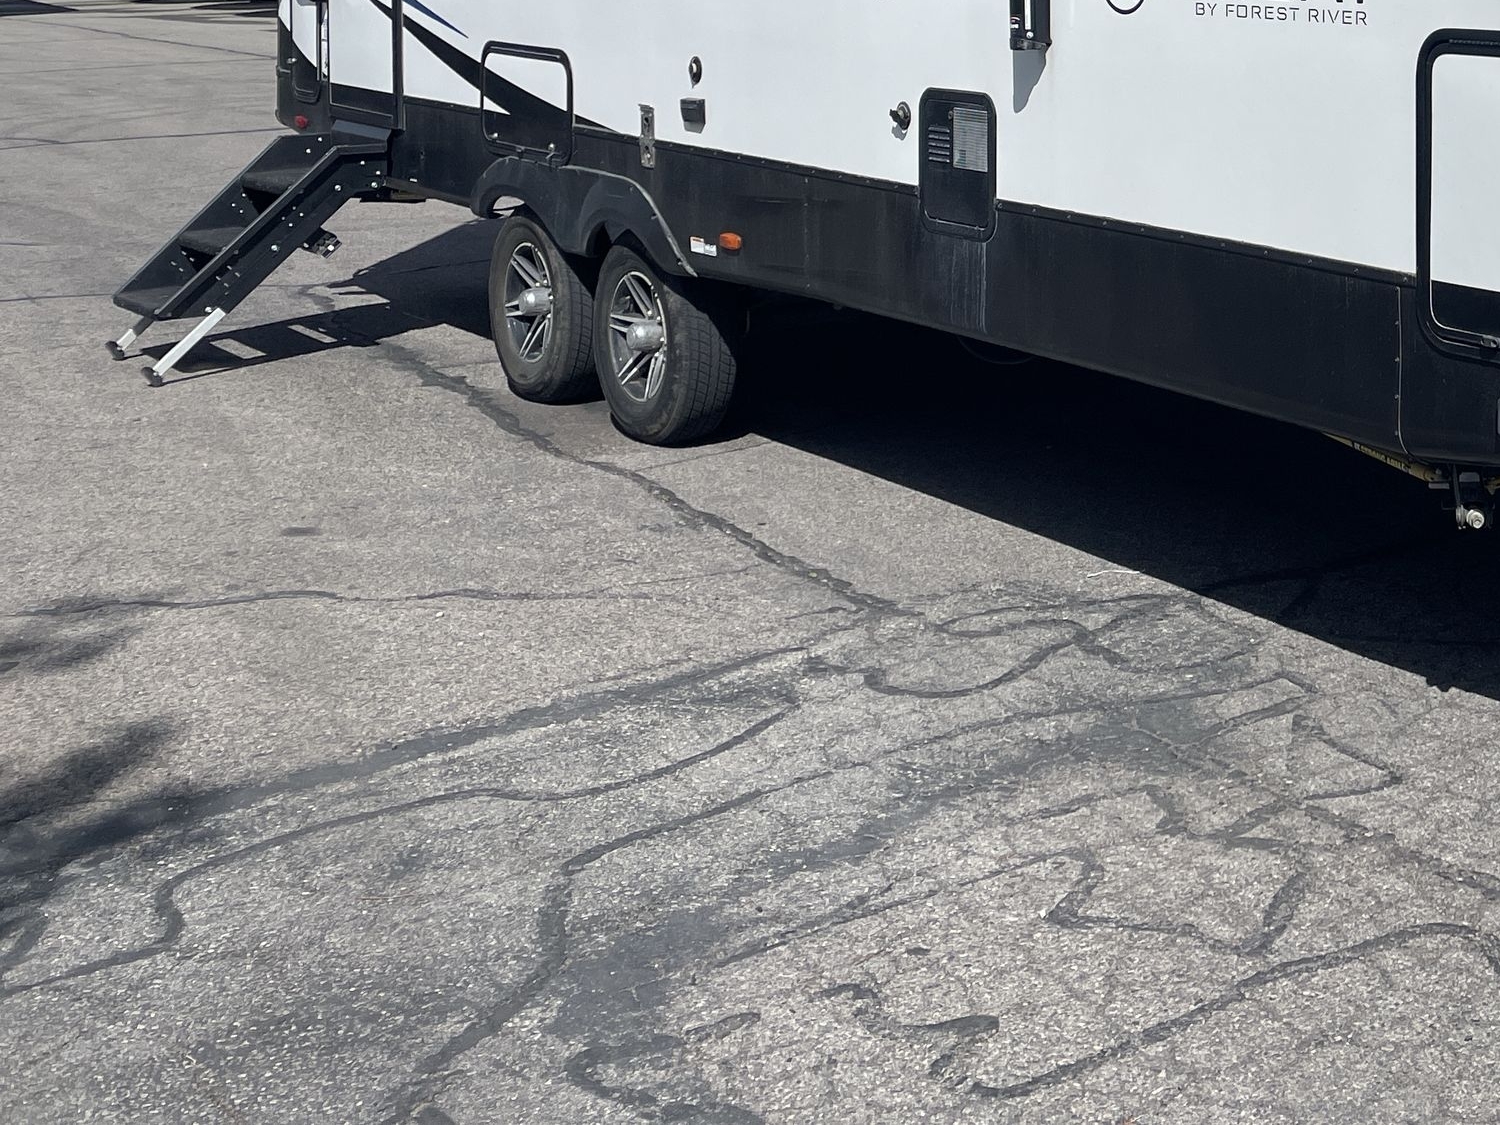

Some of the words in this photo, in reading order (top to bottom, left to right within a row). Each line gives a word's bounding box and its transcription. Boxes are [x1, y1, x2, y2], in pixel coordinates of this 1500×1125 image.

[1195, 3, 1217, 16] BY
[1225, 4, 1300, 22] FOREST
[1308, 8, 1367, 25] RIVER
